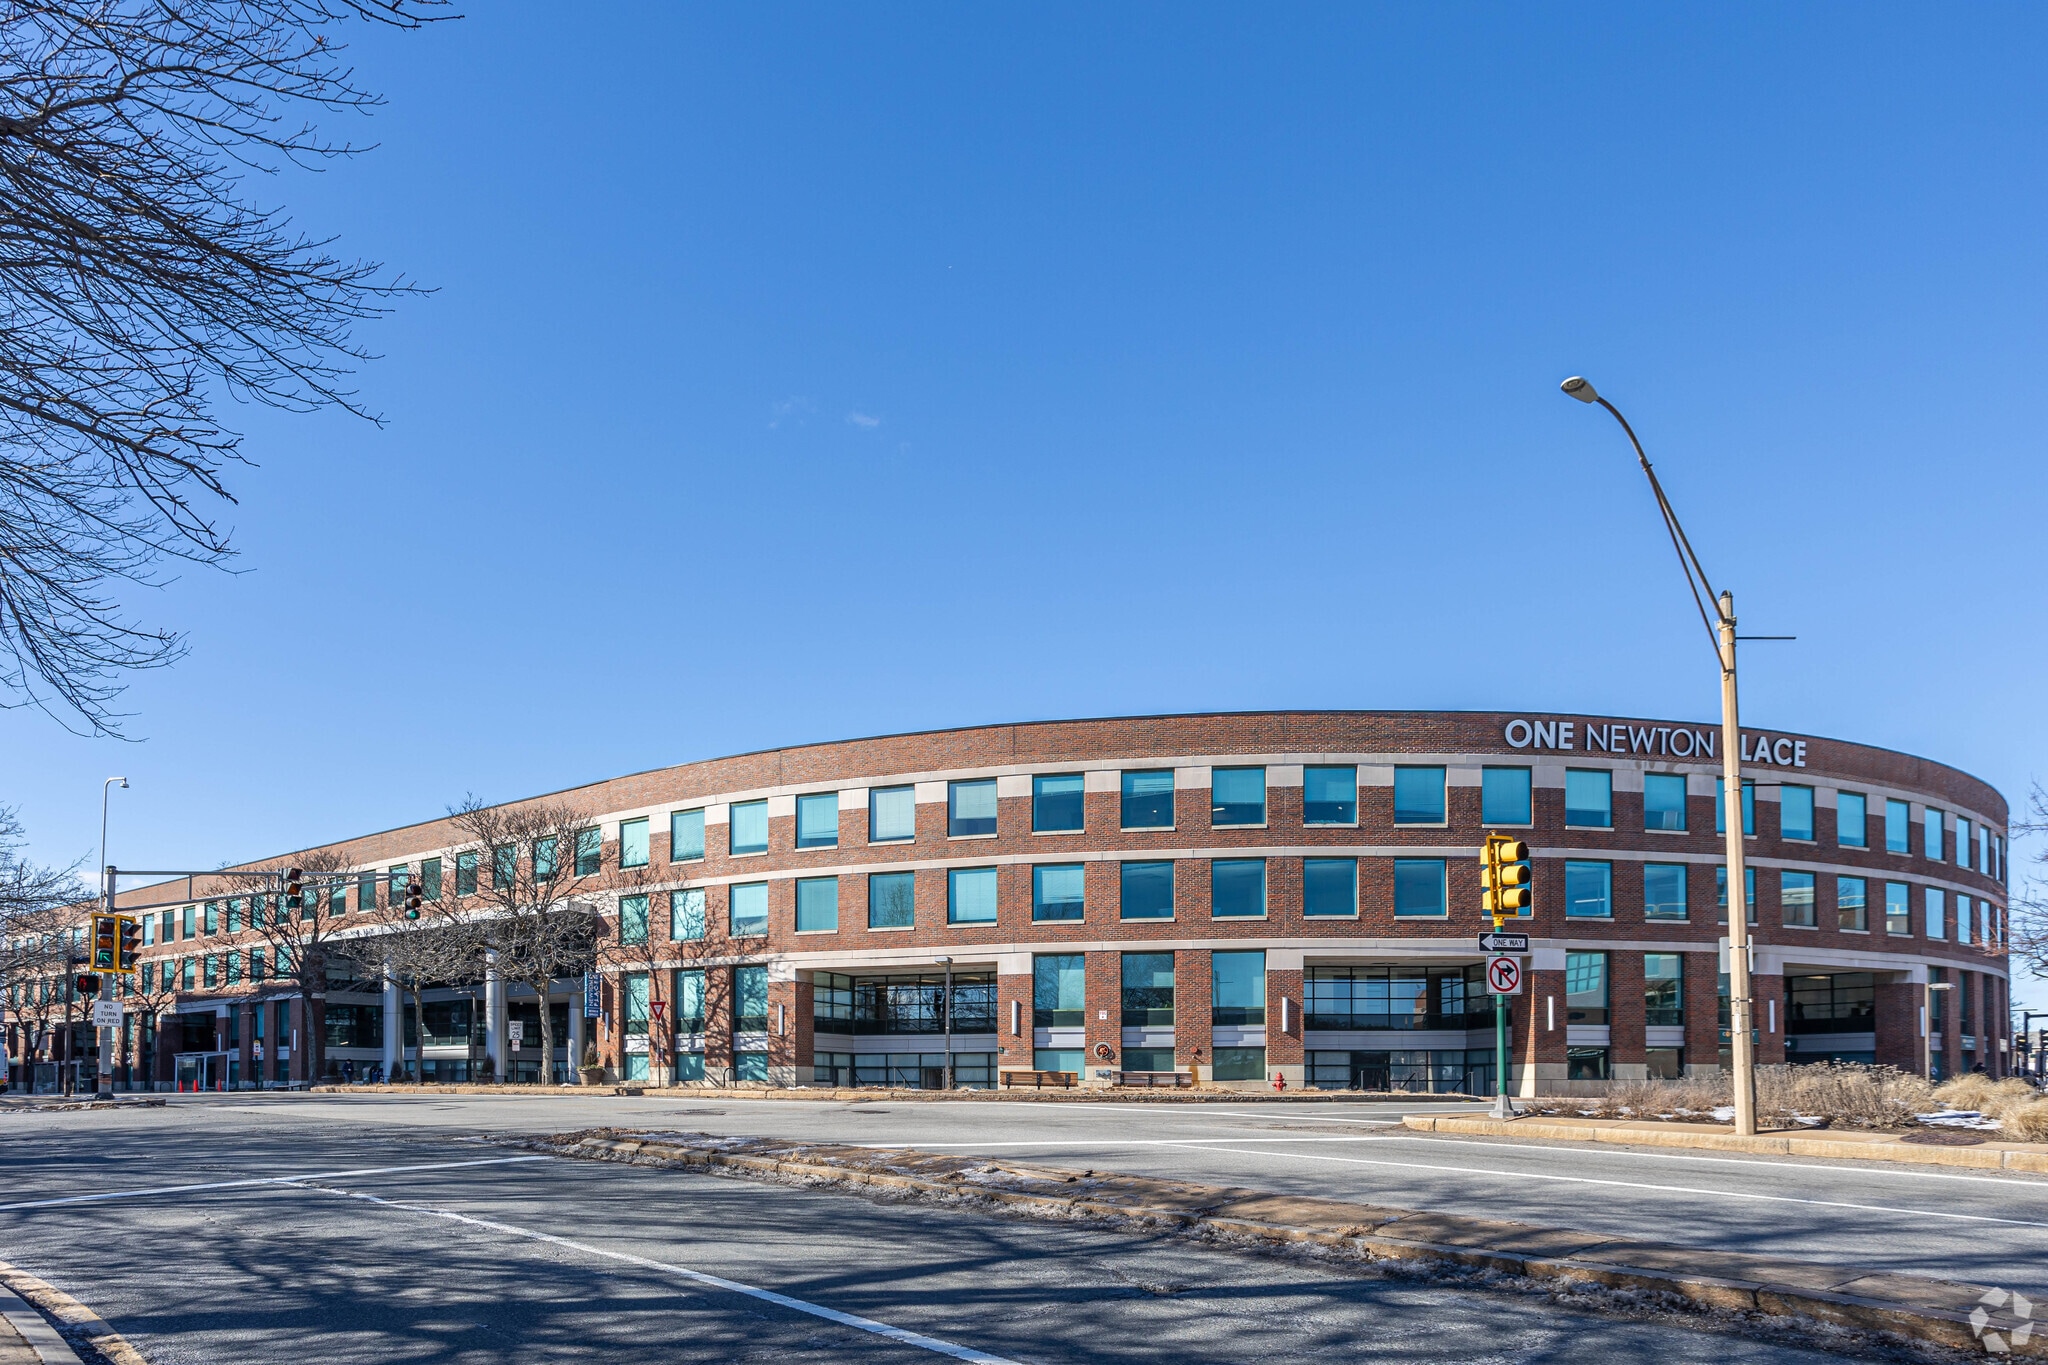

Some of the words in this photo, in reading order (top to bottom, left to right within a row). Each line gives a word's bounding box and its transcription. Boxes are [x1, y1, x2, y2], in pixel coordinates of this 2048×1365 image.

[1504, 718, 1575, 750] ONE
[1586, 722, 1715, 758] NEWTON
[1739, 733, 1807, 768] LACE
[1493, 938, 1507, 947] ONE
[1509, 938, 1524, 947] WAY
[511, 1030, 521, 1038] 25
